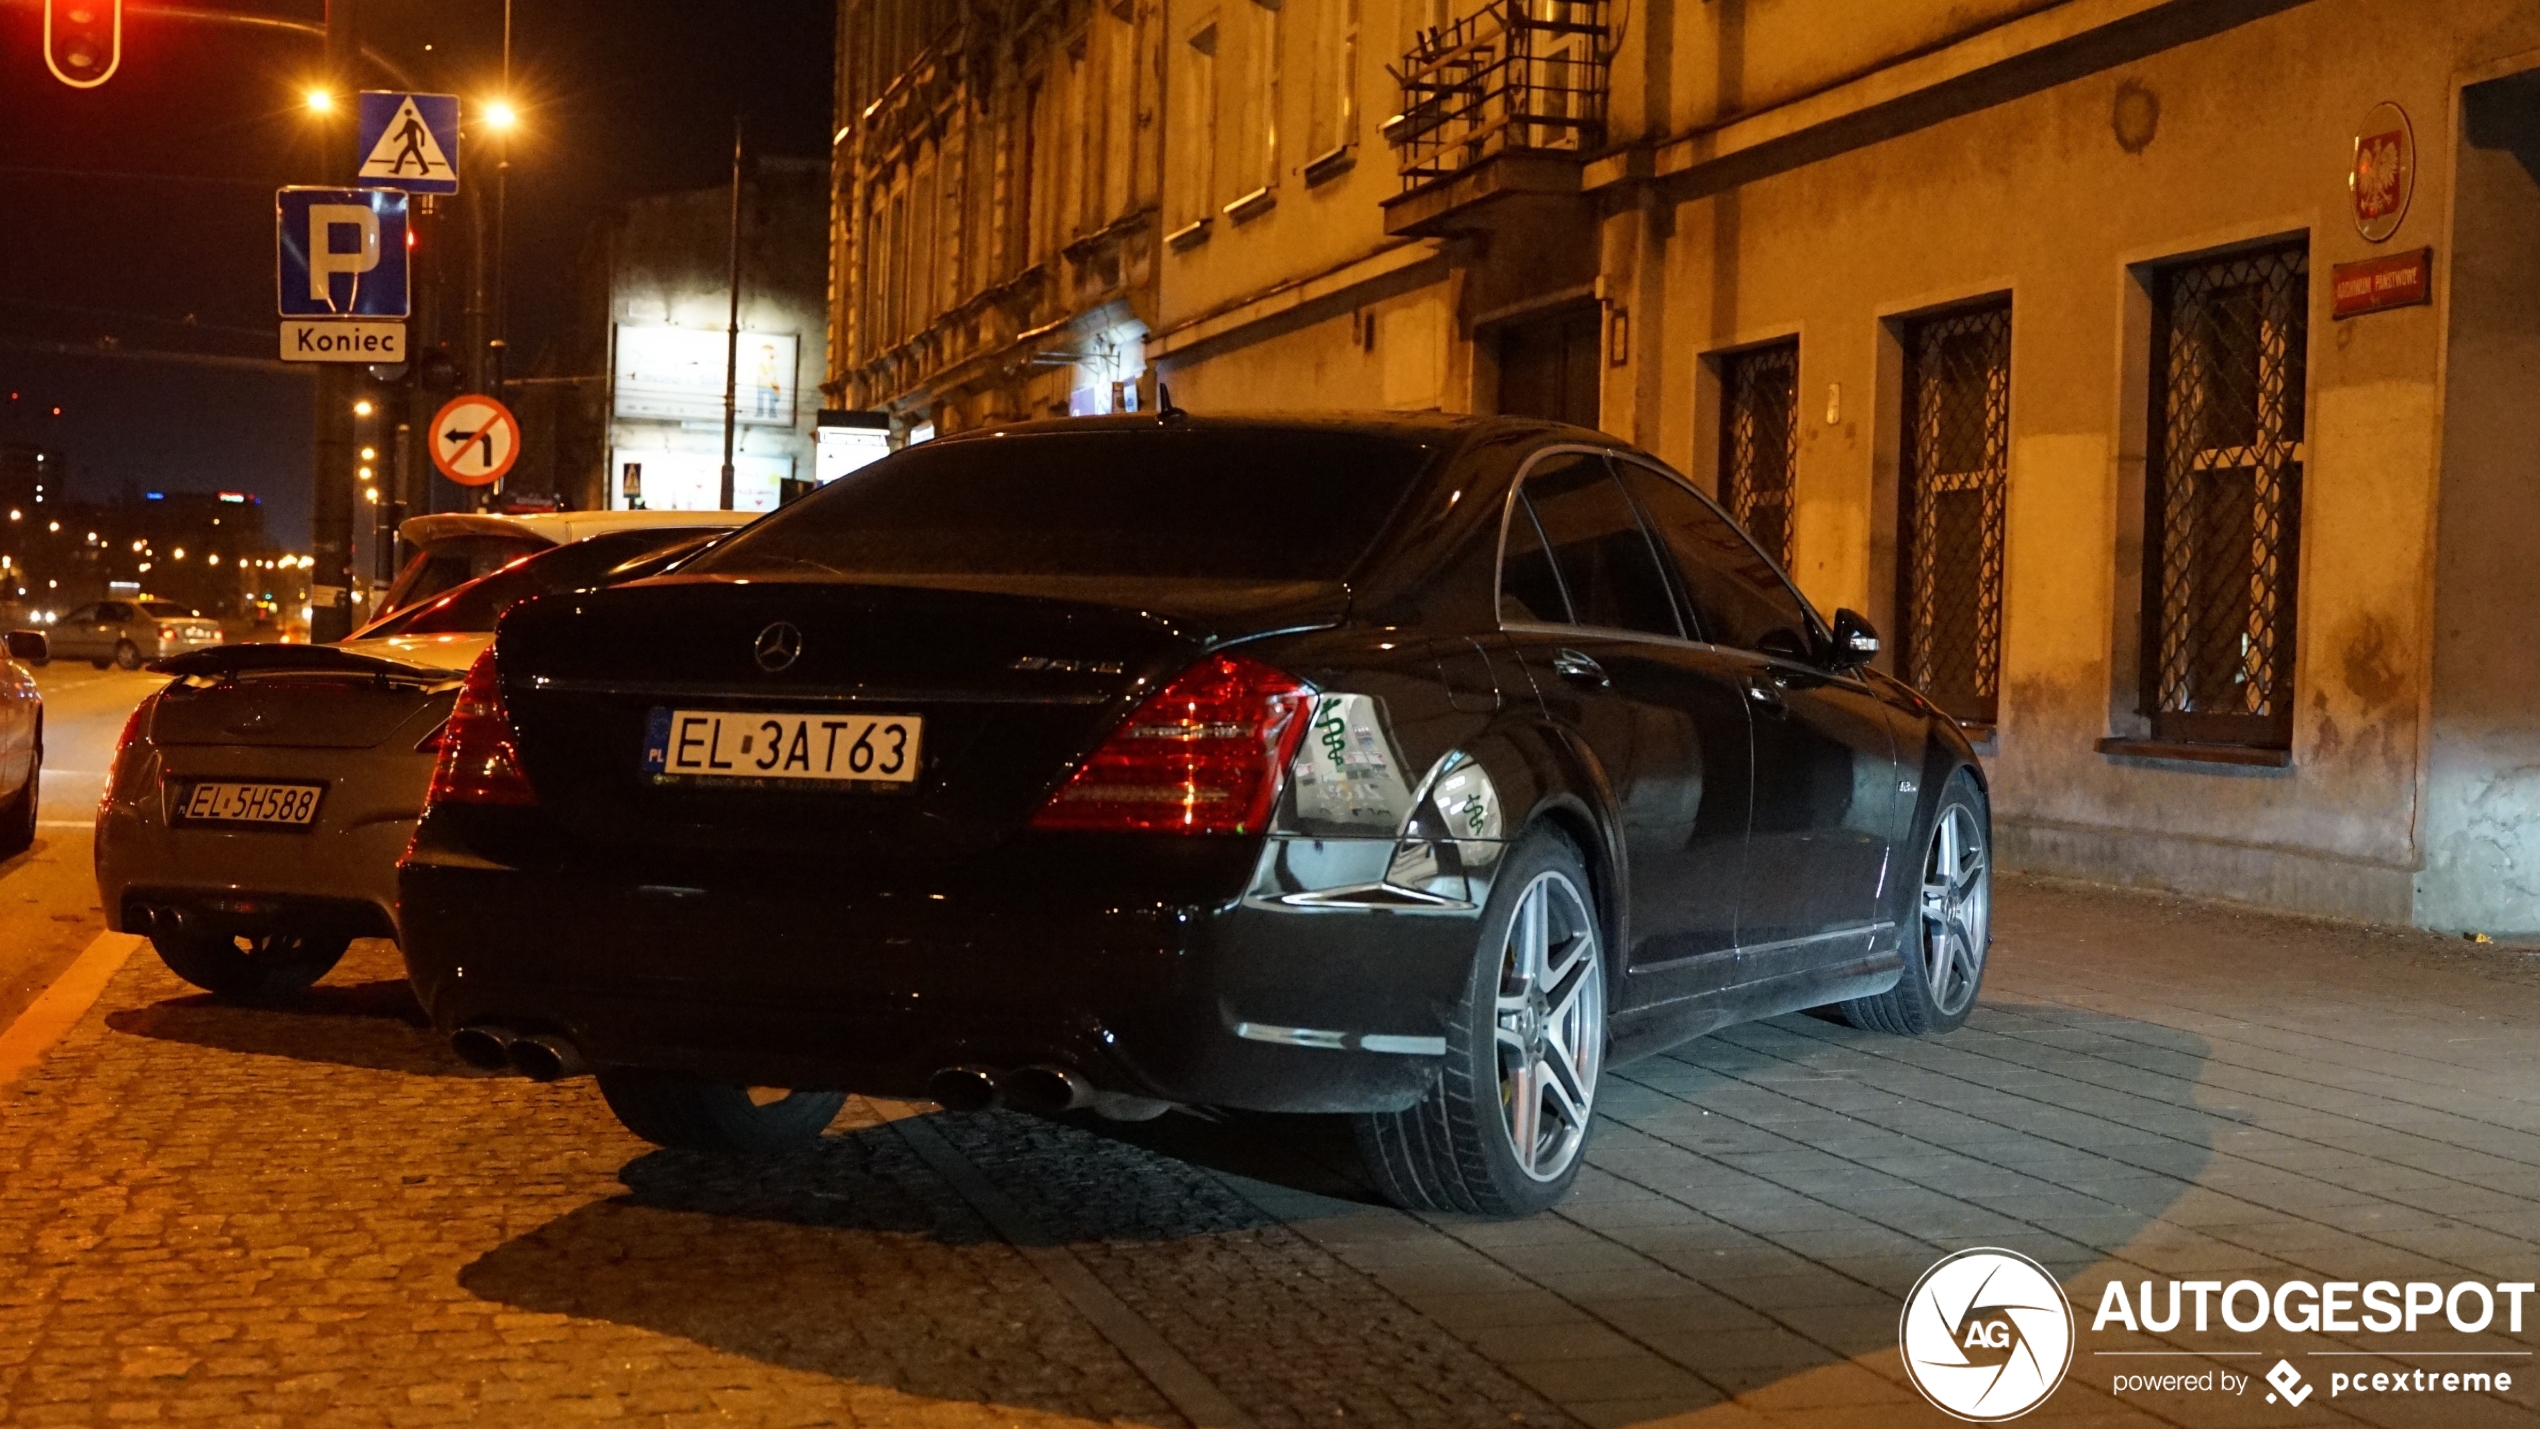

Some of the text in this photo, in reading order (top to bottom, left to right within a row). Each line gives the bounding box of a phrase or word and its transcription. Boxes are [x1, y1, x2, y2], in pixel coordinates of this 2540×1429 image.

[309, 204, 380, 300] P
[298, 327, 394, 351] Koniec
[648, 748, 664, 763] PL
[676, 717, 907, 775] EL 3AT63
[232, 786, 314, 821] 5H588
